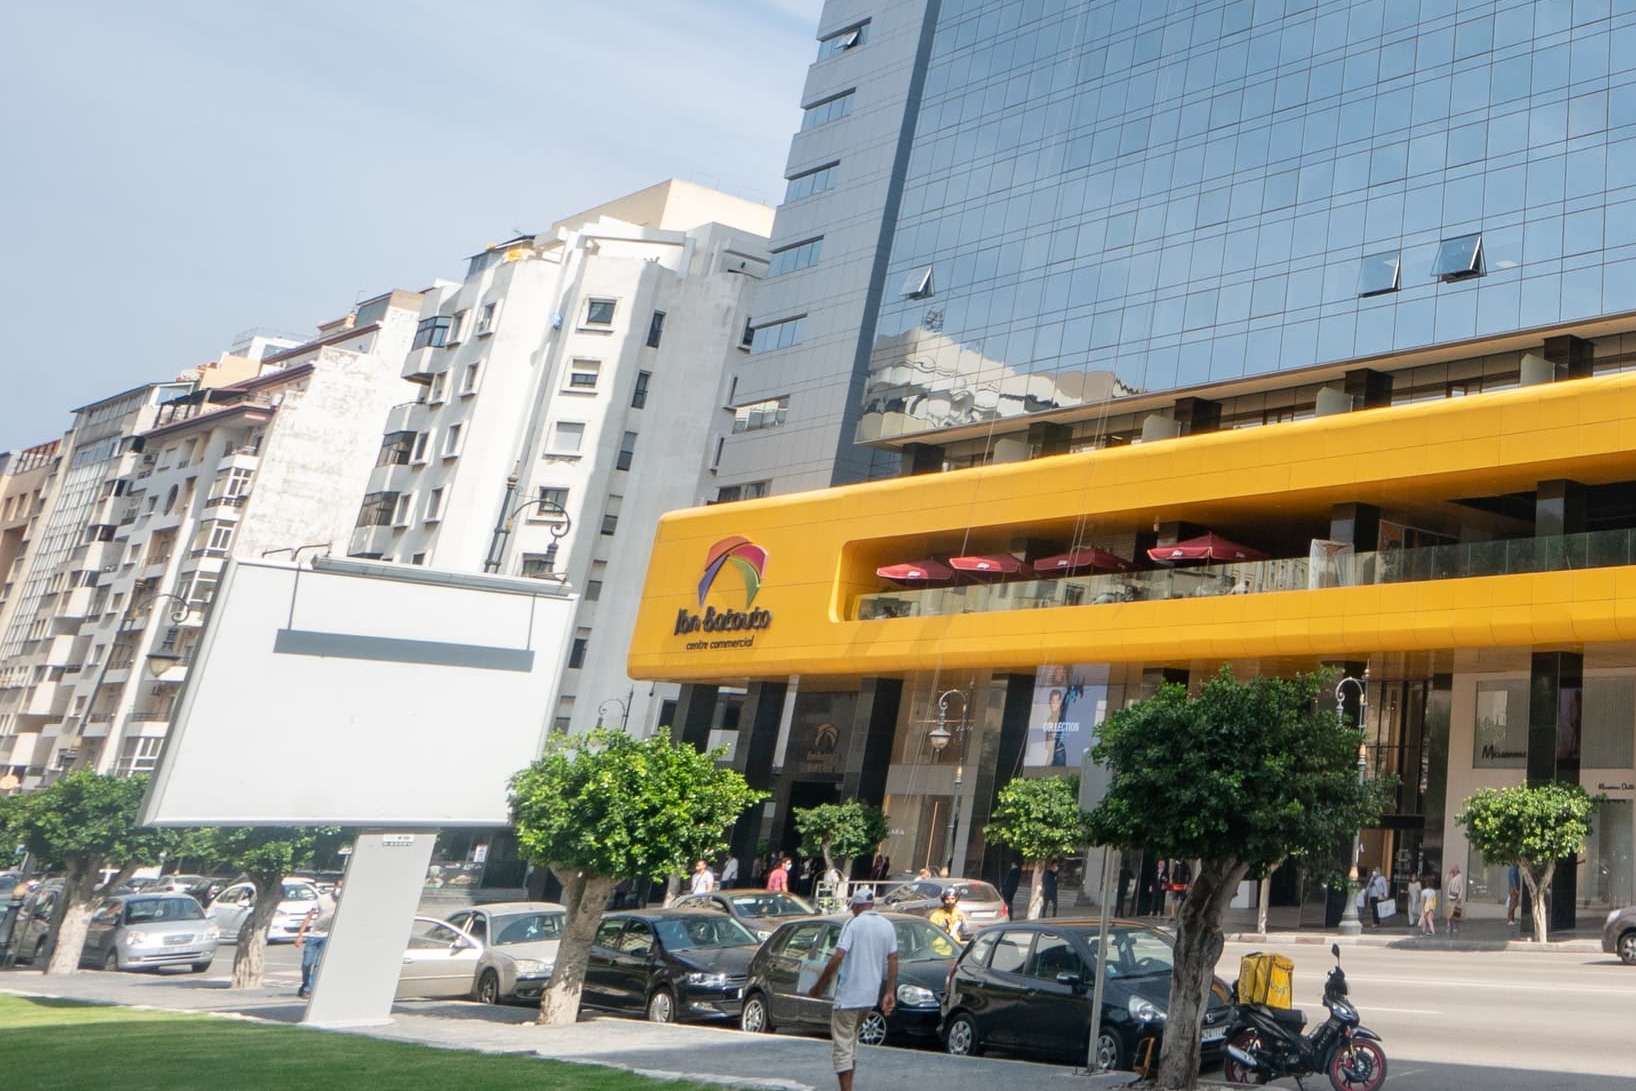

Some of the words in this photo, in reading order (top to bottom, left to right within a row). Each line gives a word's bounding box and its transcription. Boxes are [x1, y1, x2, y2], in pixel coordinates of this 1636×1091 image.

[674, 607, 700, 636] Ibn
[702, 606, 771, 633] Batouta
[686, 639, 708, 650] centre
[709, 635, 755, 650] commercial
[1043, 721, 1079, 732] COLLECTION
